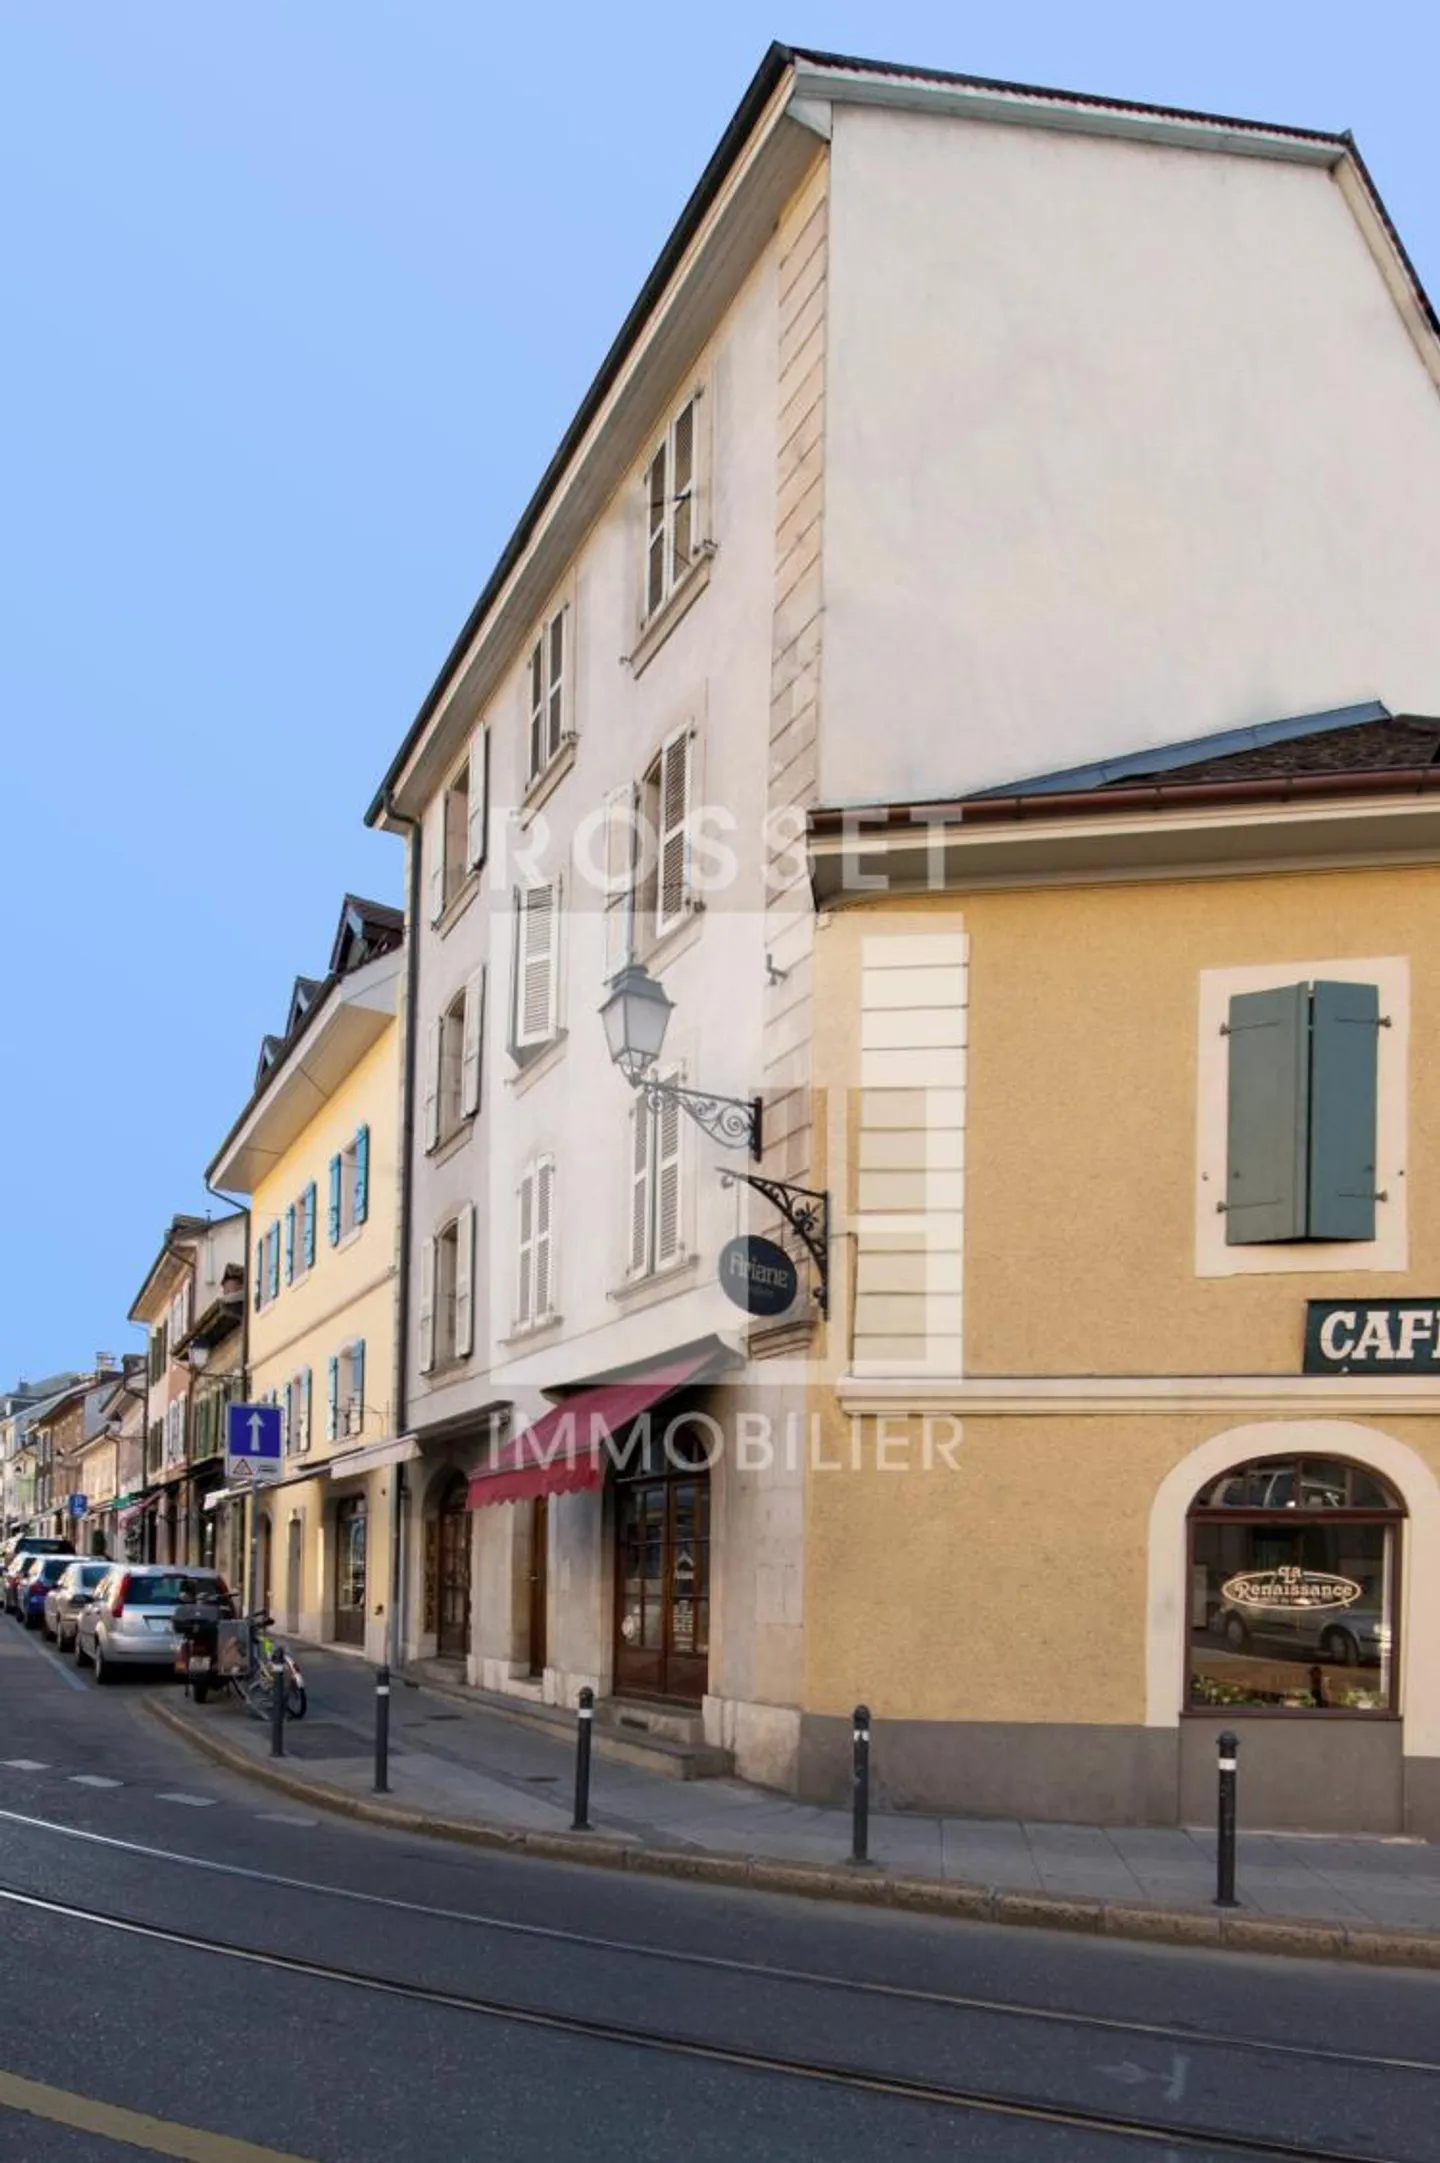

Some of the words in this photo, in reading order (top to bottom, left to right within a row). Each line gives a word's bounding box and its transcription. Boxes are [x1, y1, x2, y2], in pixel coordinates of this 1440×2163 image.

[730, 1251, 788, 1289] Ariane
[1320, 1310, 1440, 1360] CAF
[1233, 1580, 1353, 1602] Renaissance
